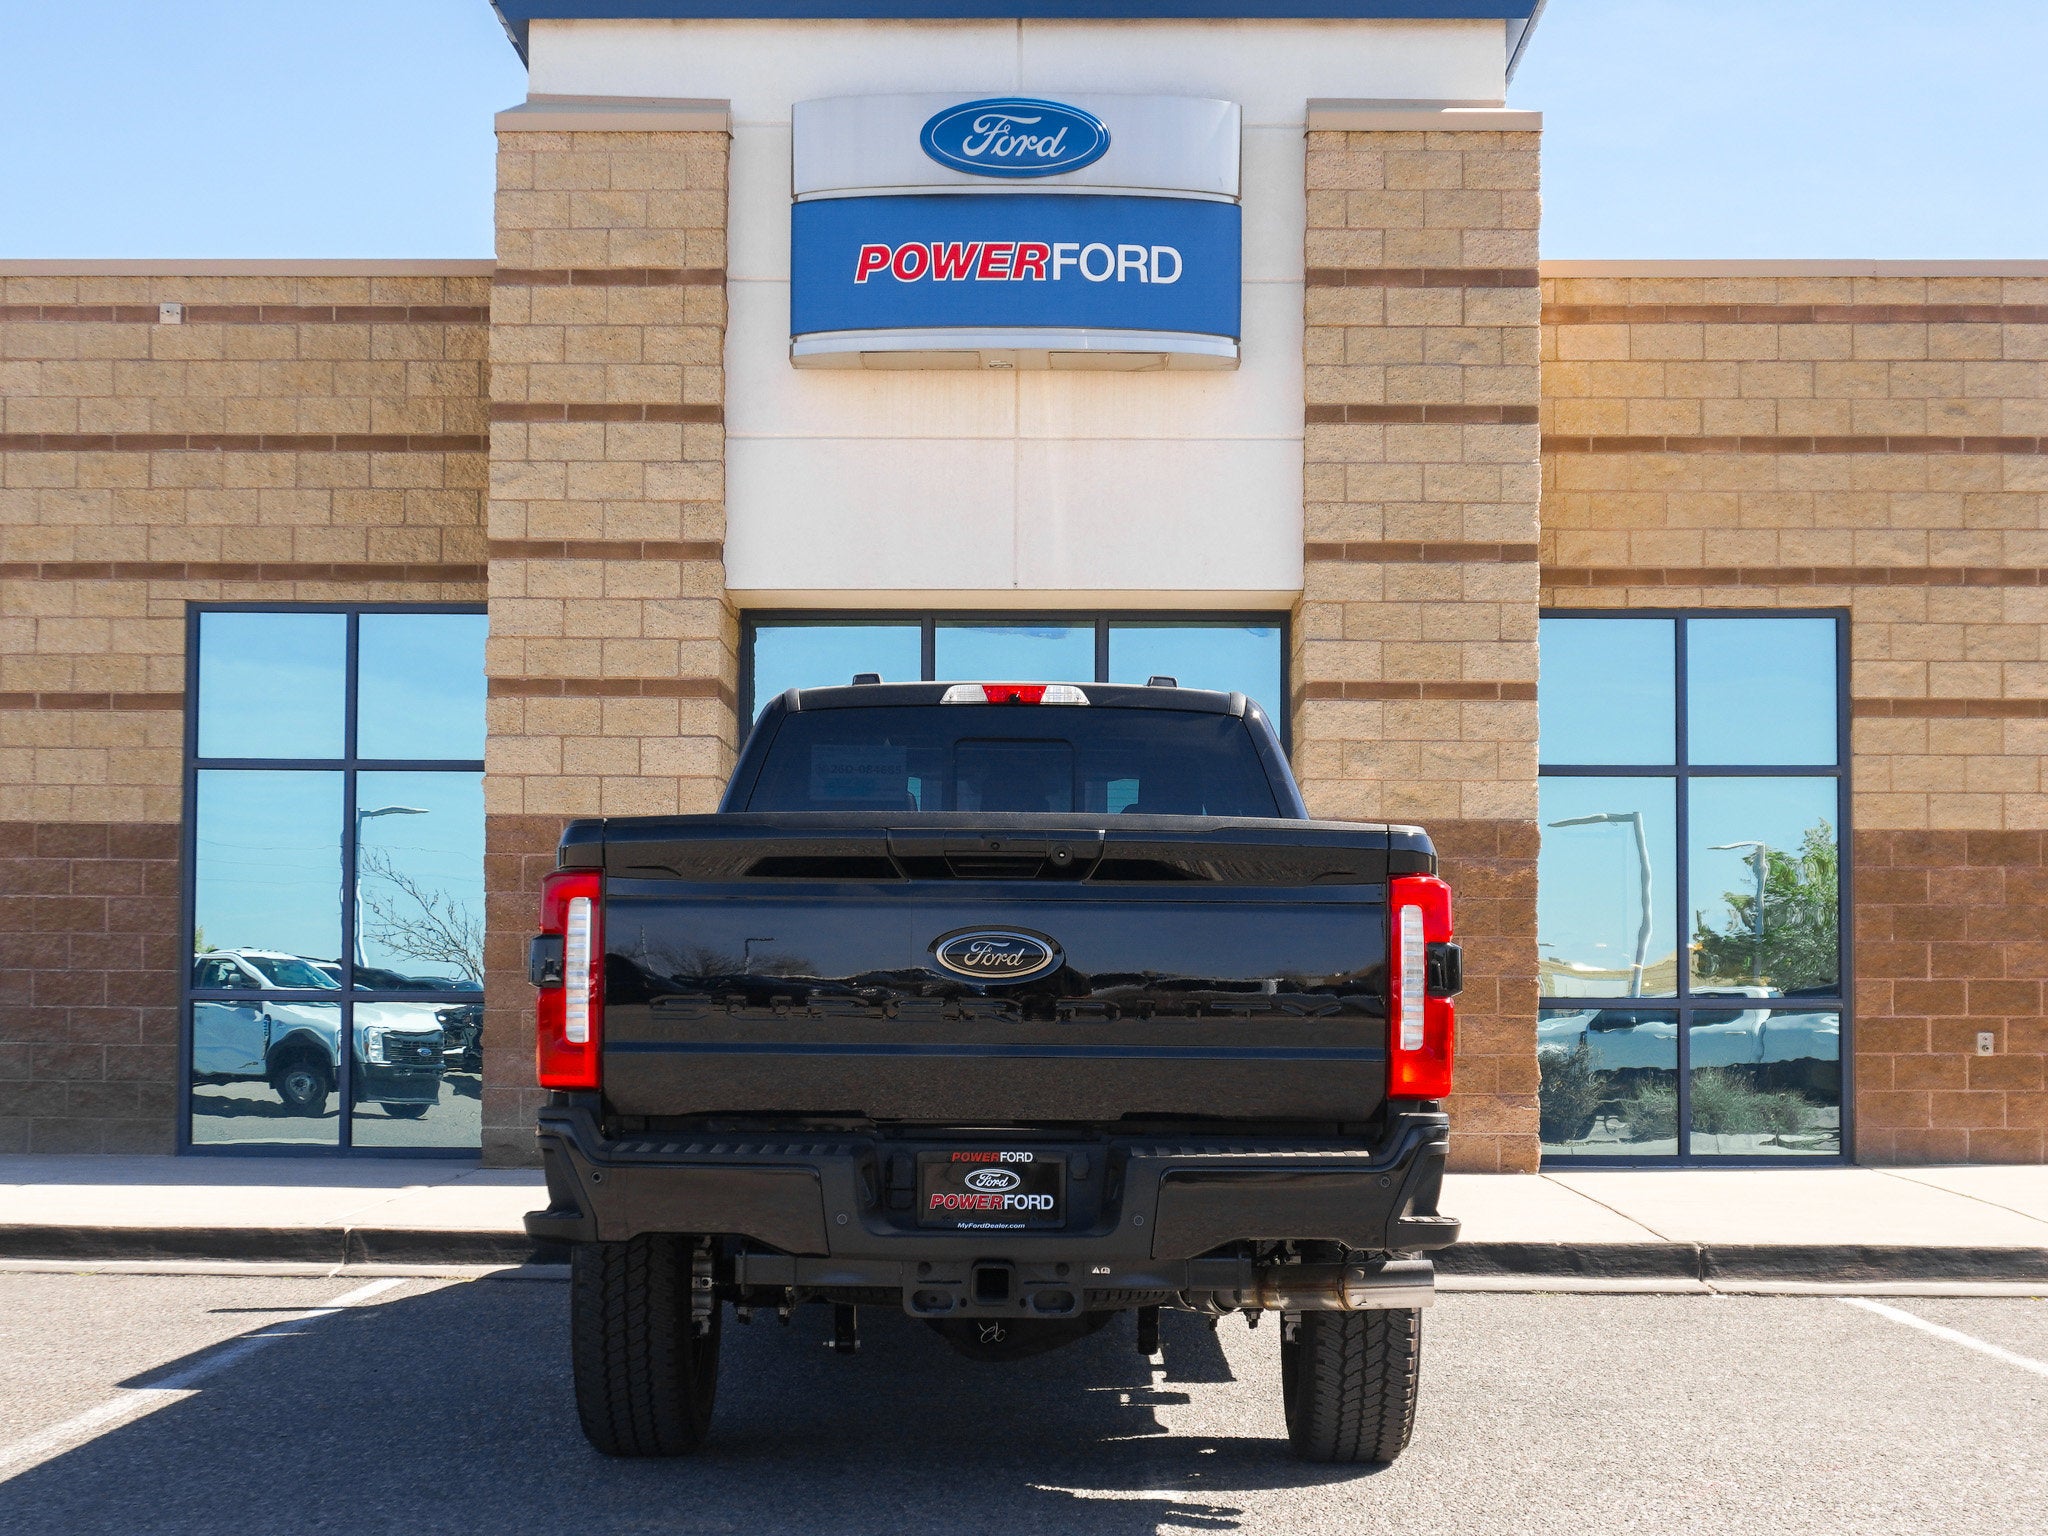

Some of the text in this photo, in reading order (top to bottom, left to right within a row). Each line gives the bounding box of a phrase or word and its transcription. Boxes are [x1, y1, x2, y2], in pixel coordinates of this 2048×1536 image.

[962, 113, 1069, 158] Ford
[853, 241, 1183, 285] POWERFORD
[963, 940, 1026, 966] Ford
[951, 1151, 1034, 1163] POWERFORD
[975, 1172, 1009, 1188] Ford
[929, 1193, 1054, 1210] POWERFORD
